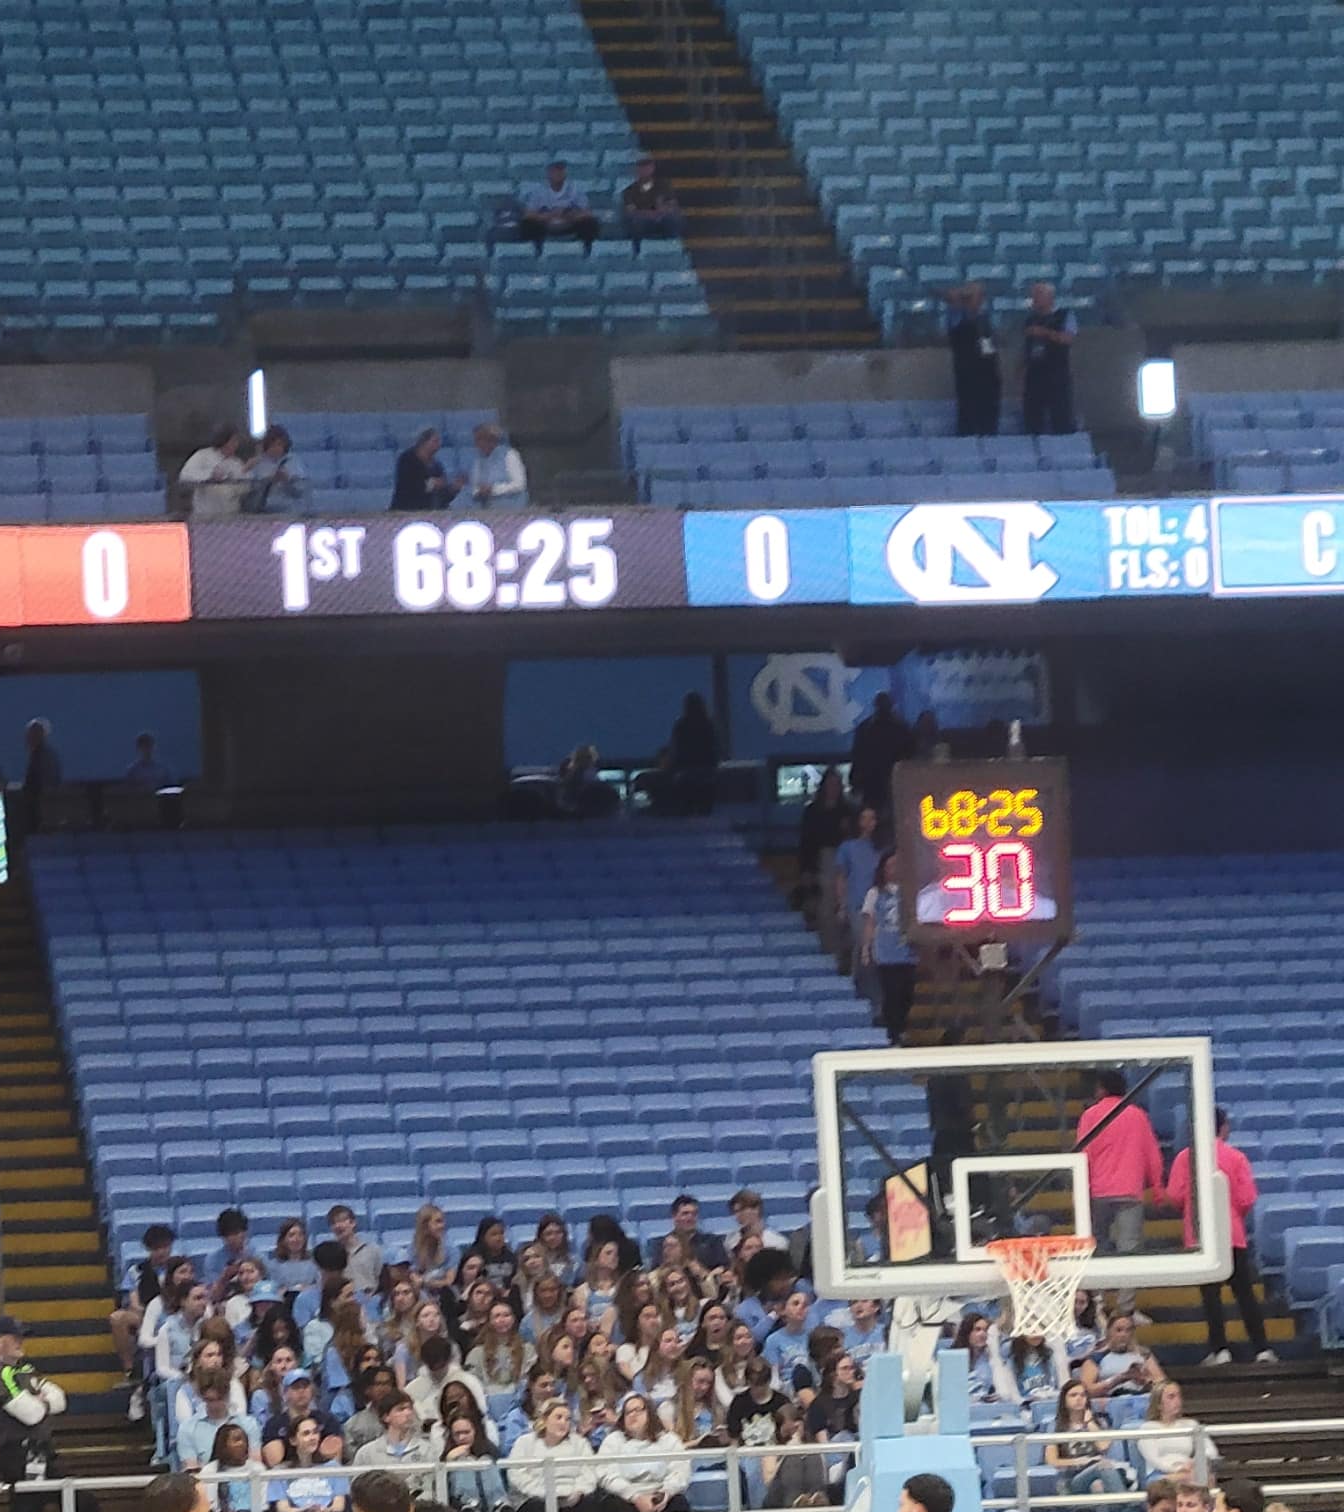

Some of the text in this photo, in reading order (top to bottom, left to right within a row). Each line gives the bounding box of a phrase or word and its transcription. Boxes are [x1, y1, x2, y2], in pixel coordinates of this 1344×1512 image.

[272, 518, 618, 611] 1ST 68:25
[744, 514, 791, 601] 0
[1104, 504, 1208, 546] TOL: 4
[82, 530, 128, 618] 0
[1108, 546, 1210, 591] FLS: 0
[920, 788, 1044, 840] 68:25
[942, 840, 1036, 923] 30
